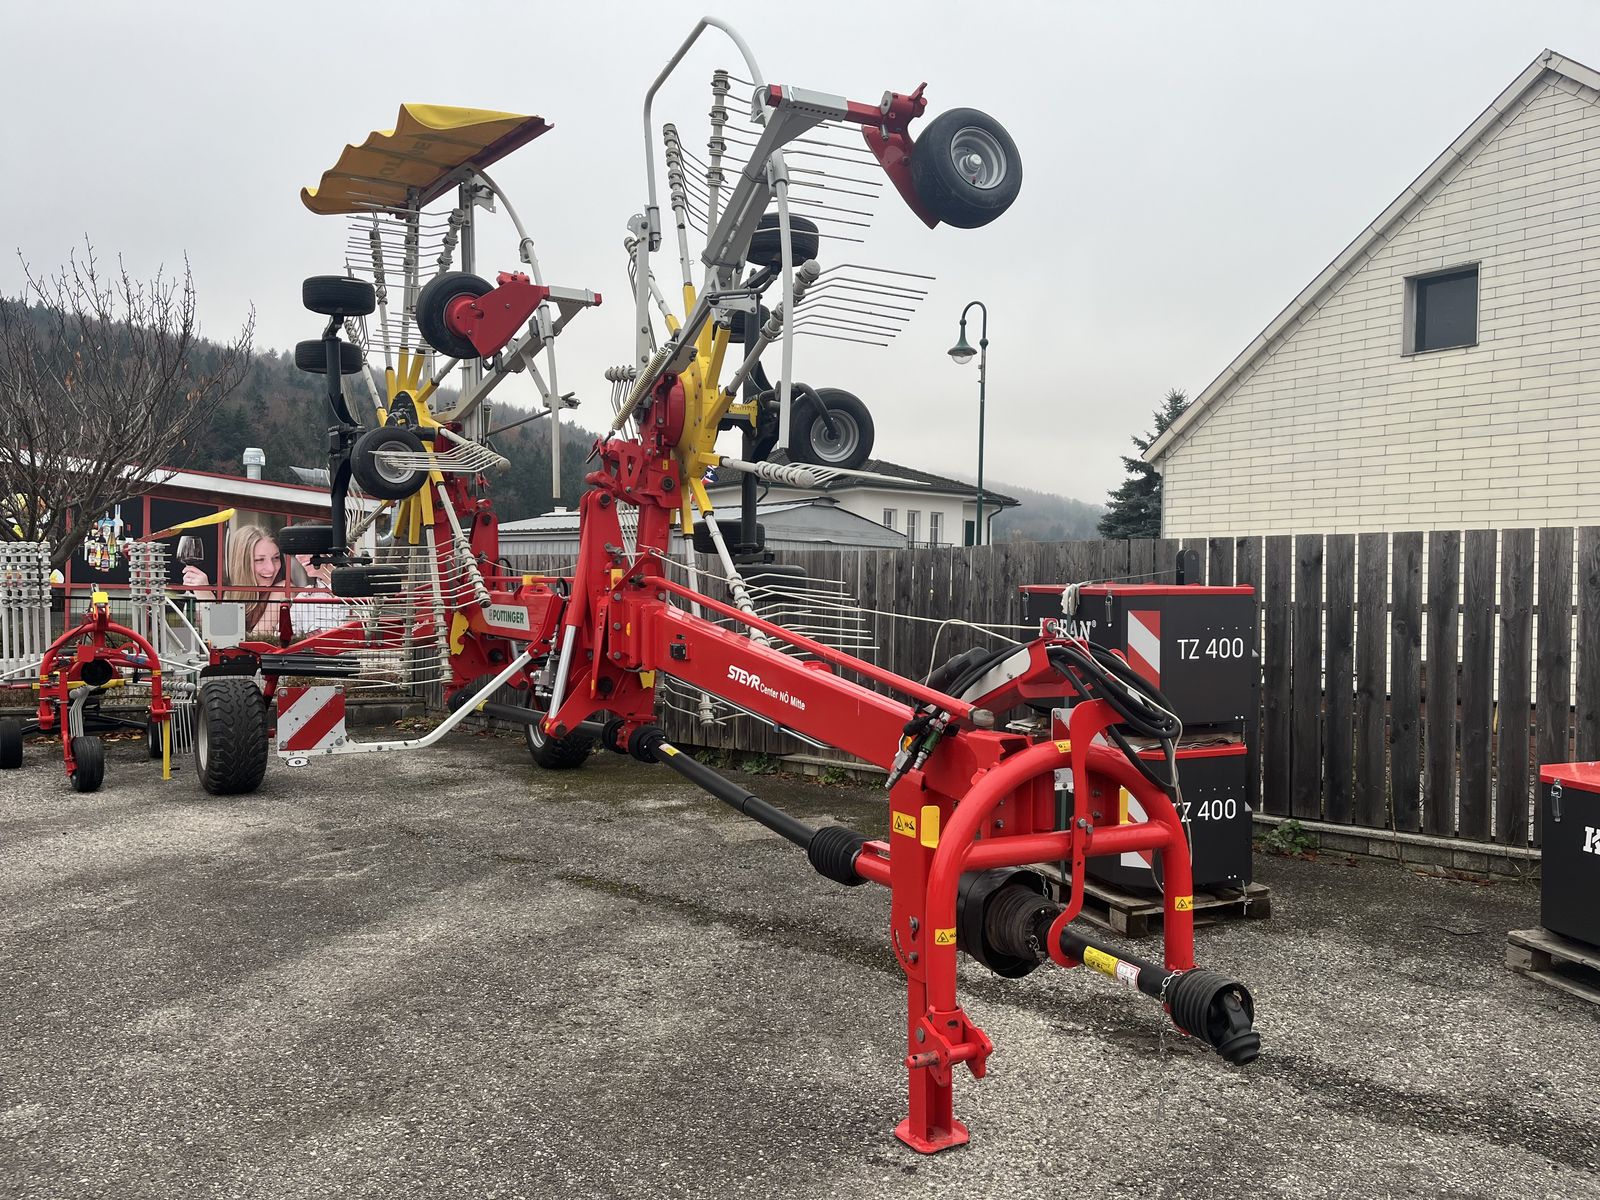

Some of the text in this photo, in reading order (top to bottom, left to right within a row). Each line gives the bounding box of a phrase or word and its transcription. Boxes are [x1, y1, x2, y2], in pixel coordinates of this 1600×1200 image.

[1177, 637, 1244, 660] TZ 400
[727, 664, 761, 691] STEYR
[760, 683, 779, 699] Center
[790, 695, 806, 711] Mitte
[1197, 798, 1237, 821] 400
